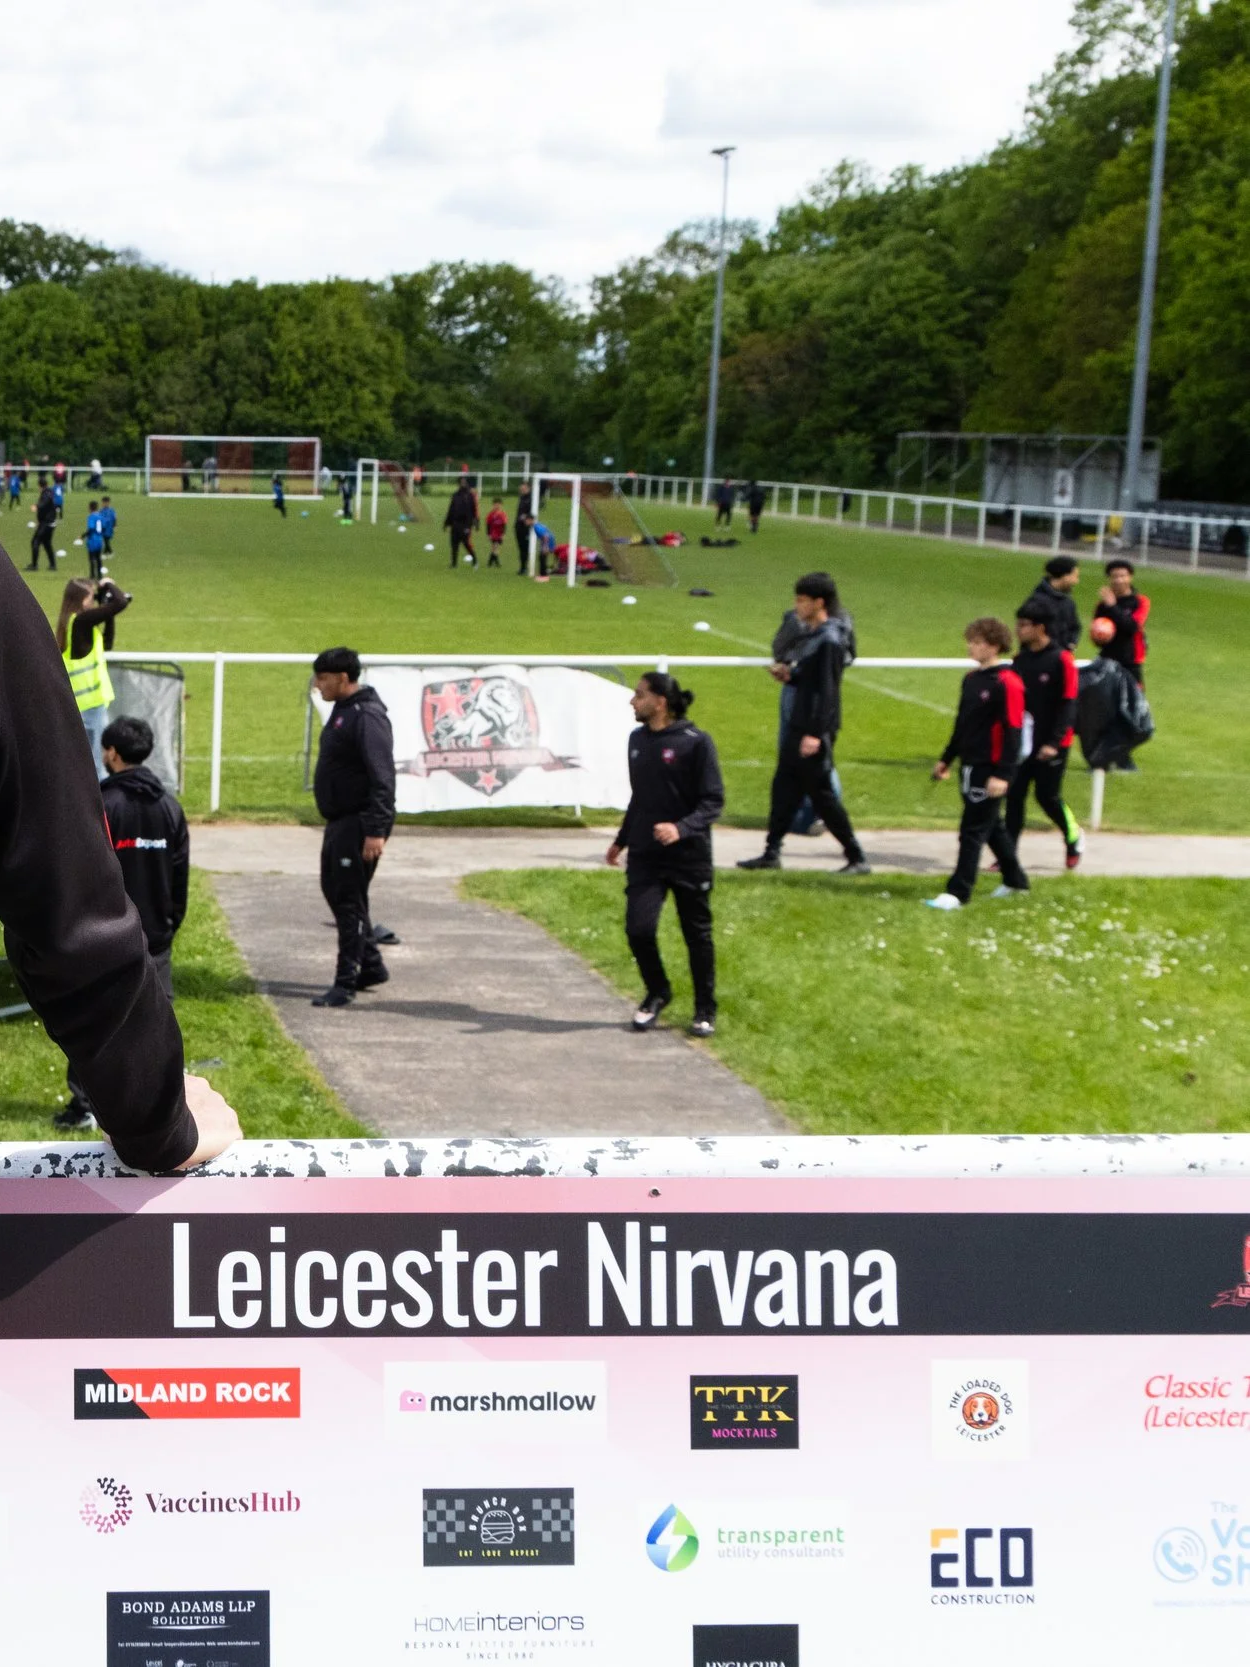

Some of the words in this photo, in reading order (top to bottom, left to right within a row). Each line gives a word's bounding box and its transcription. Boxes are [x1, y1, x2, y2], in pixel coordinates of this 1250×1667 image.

[172, 1221, 559, 1329] Leicester
[587, 1220, 900, 1328] Nirvana
[84, 1382, 208, 1404] MIDLAND
[215, 1381, 292, 1403] ROCK
[1144, 1374, 1232, 1399] Classic
[430, 1391, 597, 1412] marshmallow
[693, 1385, 795, 1422] TTK
[949, 1390, 963, 1409] THE
[961, 1379, 1002, 1393] LOADED
[1000, 1392, 1013, 1415] DOG
[711, 1427, 778, 1439] MOCKTAILS
[955, 1424, 1007, 1442] LEICESTER
[145, 1490, 301, 1514] VaccinesHub
[1211, 1500, 1239, 1513] The
[717, 1527, 845, 1547] transparent
[717, 1547, 760, 1560] utility
[764, 1546, 845, 1559] consultants
[930, 1527, 1034, 1589] ECO
[121, 1601, 166, 1614] BOND
[170, 1600, 225, 1614] ADAMS
[228, 1600, 257, 1613] LLP
[930, 1593, 1036, 1606] CONSTRUCTION
[151, 1615, 227, 1626] SOLICITORS
[404, 1641, 461, 1650] BESPOKE
[465, 1651, 500, 1660] SINCE
